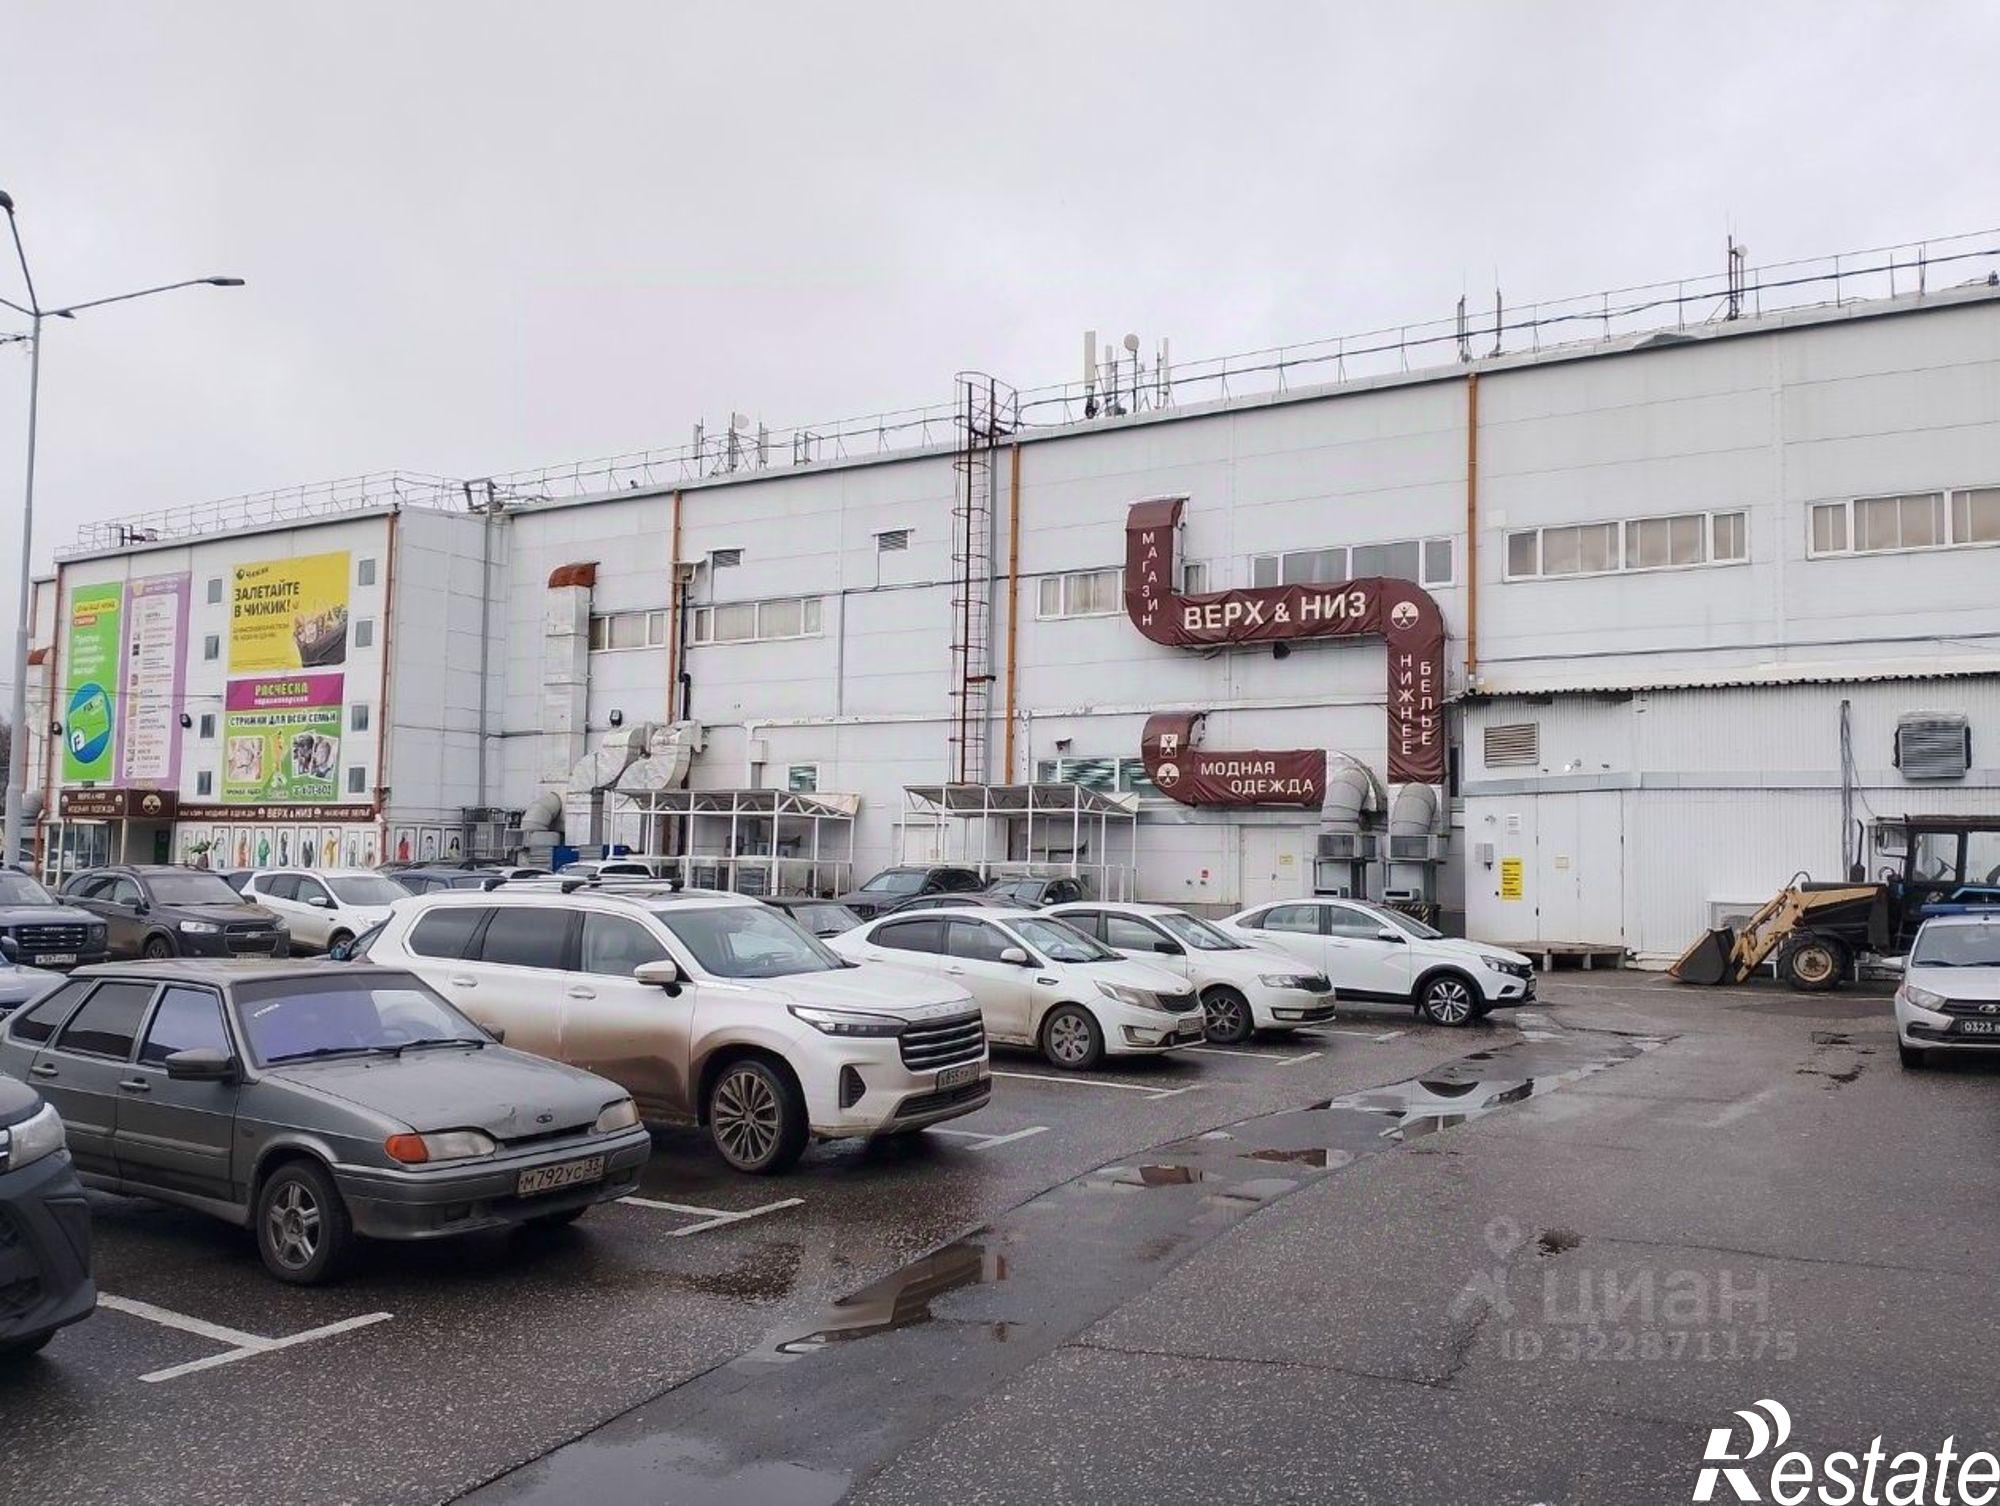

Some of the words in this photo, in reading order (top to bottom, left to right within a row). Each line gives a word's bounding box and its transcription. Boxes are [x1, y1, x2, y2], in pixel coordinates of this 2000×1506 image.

[1142, 531, 1158, 627] МАГАЗИН
[235, 579, 300, 601] ЗАЛЕТАЙТЕ
[234, 604, 242, 618] В
[244, 600, 291, 616] ЧИЖИК!
[1184, 601, 1264, 630] ВЕРХ
[1274, 602, 1290, 622] &
[1301, 592, 1366, 620] НИЗ
[1399, 654, 1415, 756] НИЖНЕЕ
[1420, 660, 1433, 746] БЕЛЬЕ
[268, 714, 285, 725] ДЛЯ
[1200, 761, 1275, 778] МОДНАЯ
[1231, 779, 1314, 795] ОДЕЖДА
[267, 808, 288, 818] ВЕРХ
[295, 807, 312, 818] НИЗ
[1964, 1021, 1993, 1033] 0323
[522, 1166, 582, 1191] М792УС
[586, 1159, 600, 1173] 33
